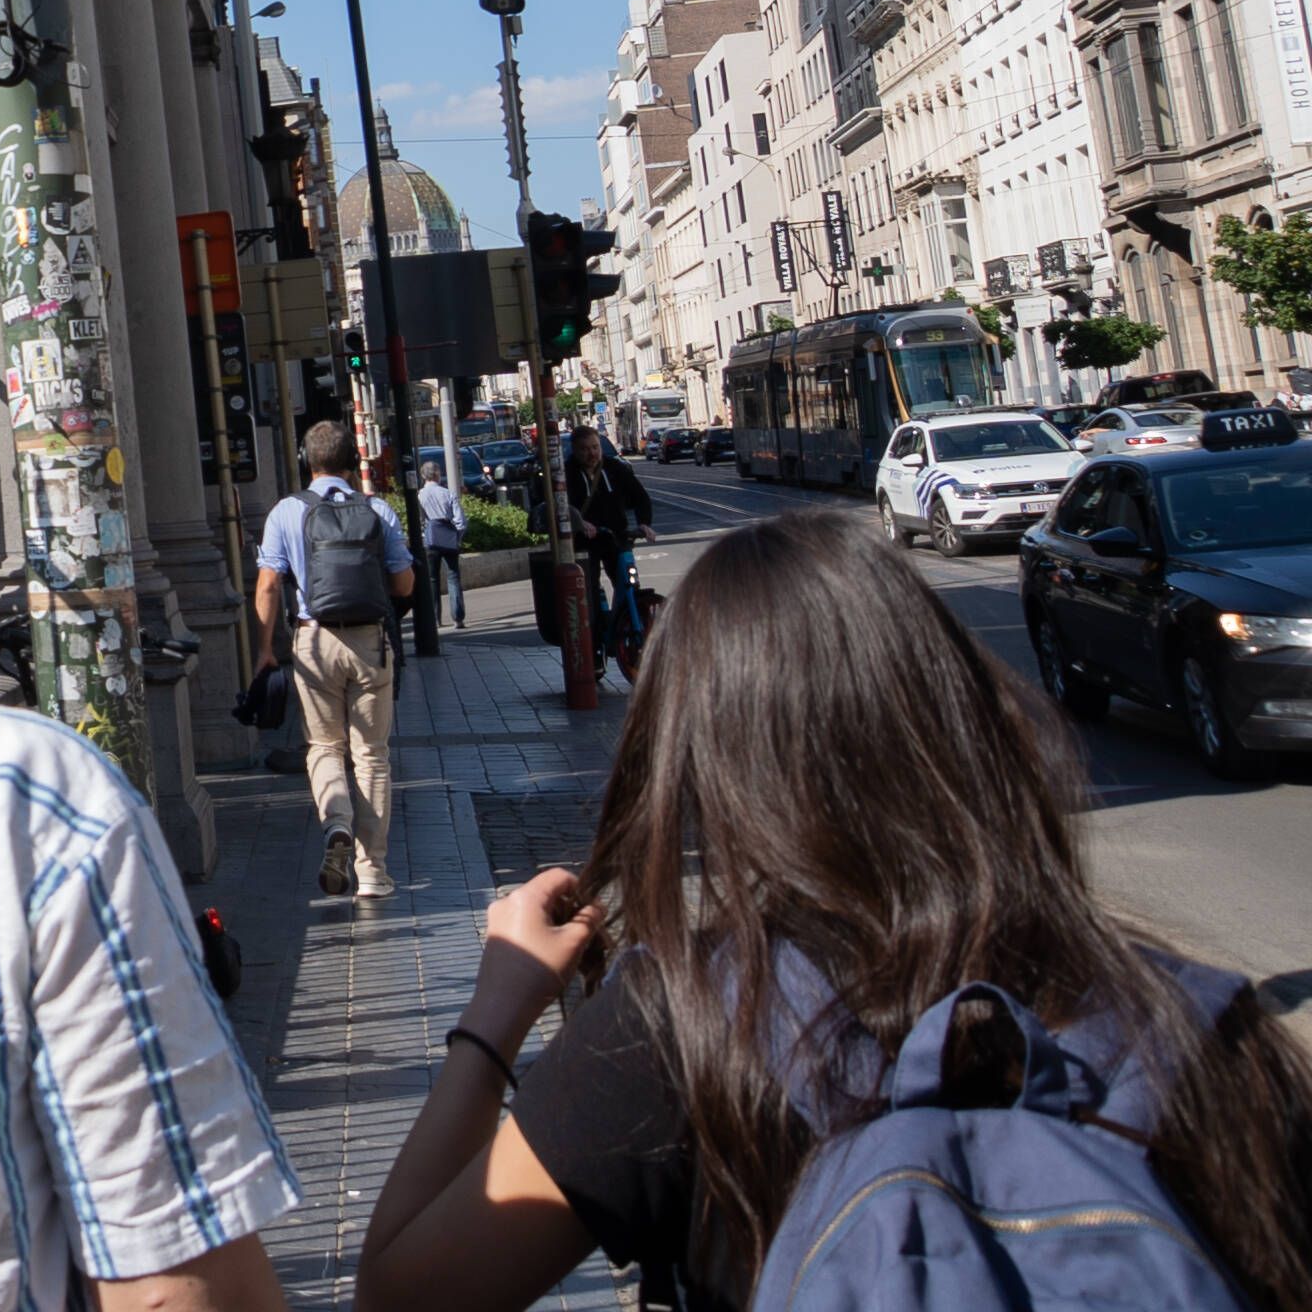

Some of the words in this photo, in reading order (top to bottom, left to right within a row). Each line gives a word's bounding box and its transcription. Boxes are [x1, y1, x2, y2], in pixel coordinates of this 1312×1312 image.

[1285, 55, 1312, 109] HOTEL
[780, 262, 793, 290] VILLA
[33, 378, 84, 407] RICKS
[1219, 413, 1276, 432] TAXI
